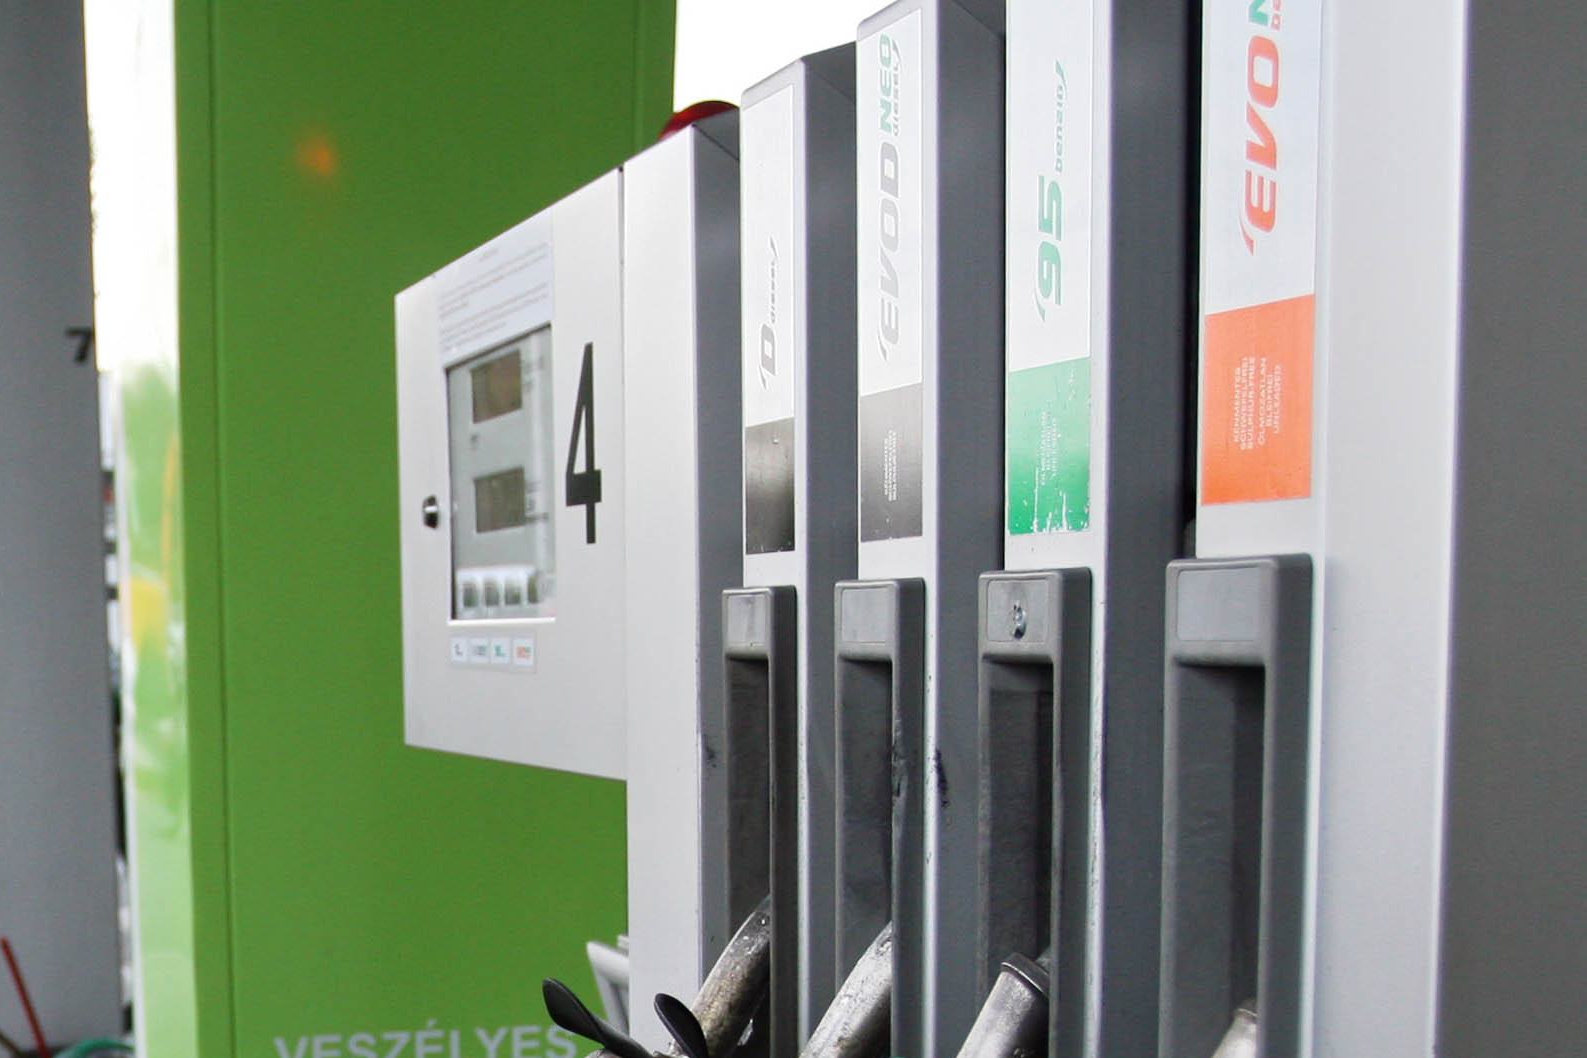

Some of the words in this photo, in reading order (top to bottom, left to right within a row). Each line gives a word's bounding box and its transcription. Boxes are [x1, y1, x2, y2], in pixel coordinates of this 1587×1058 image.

[879, 33, 892, 133] NEO
[1244, 35, 1280, 233] EVO
[1038, 175, 1062, 306] 95
[65, 326, 94, 365] 7
[566, 343, 602, 544] 4
